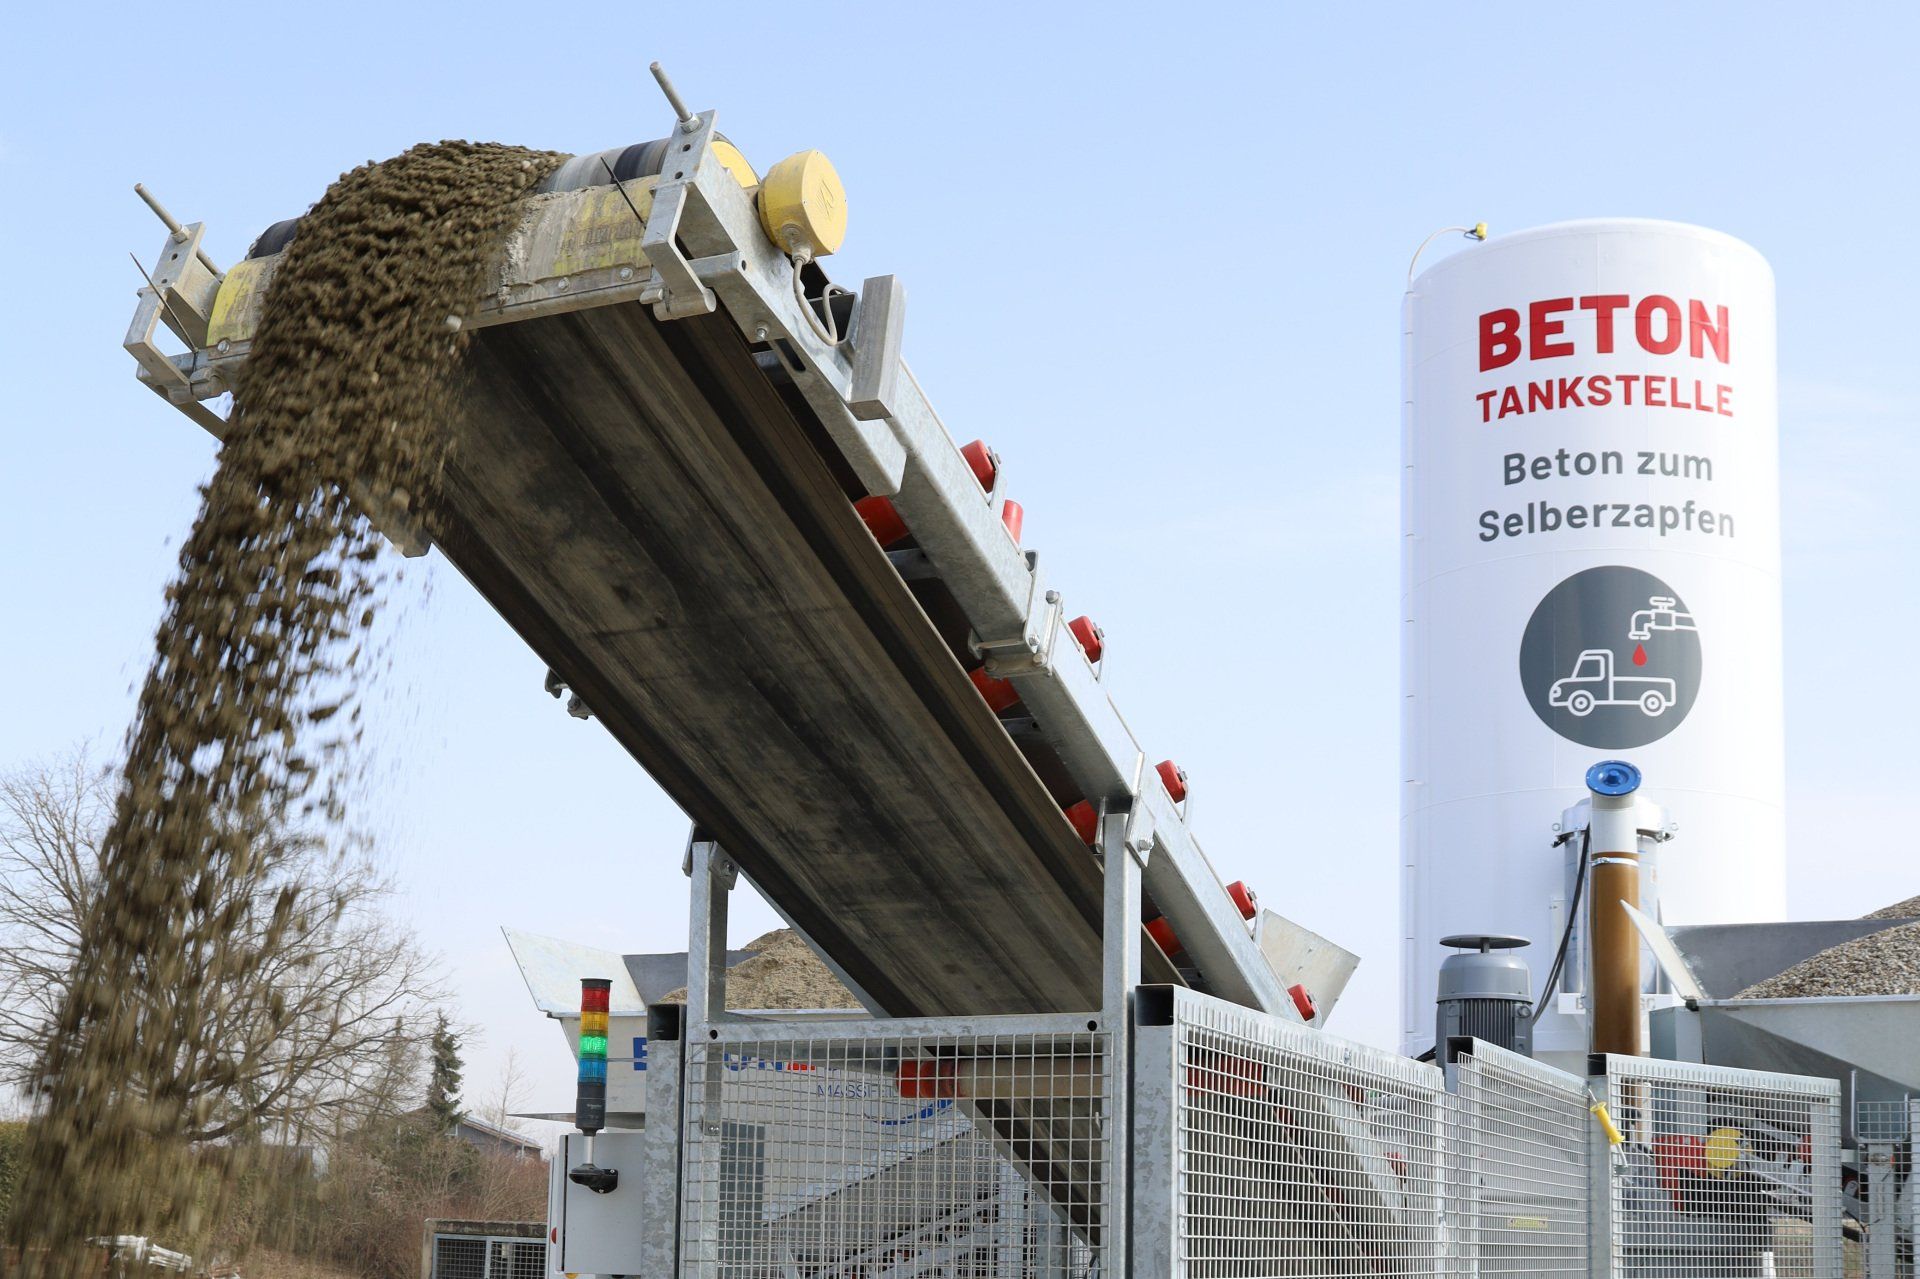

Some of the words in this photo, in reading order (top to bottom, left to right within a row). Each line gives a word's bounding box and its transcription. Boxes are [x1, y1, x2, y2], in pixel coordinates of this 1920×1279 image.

[1479, 294, 1730, 373] BETON
[1475, 374, 1734, 423] TANKSTELLE
[1503, 448, 1623, 486] Beton
[1637, 450, 1713, 481] zum
[1478, 500, 1735, 542] Selberzapfen
